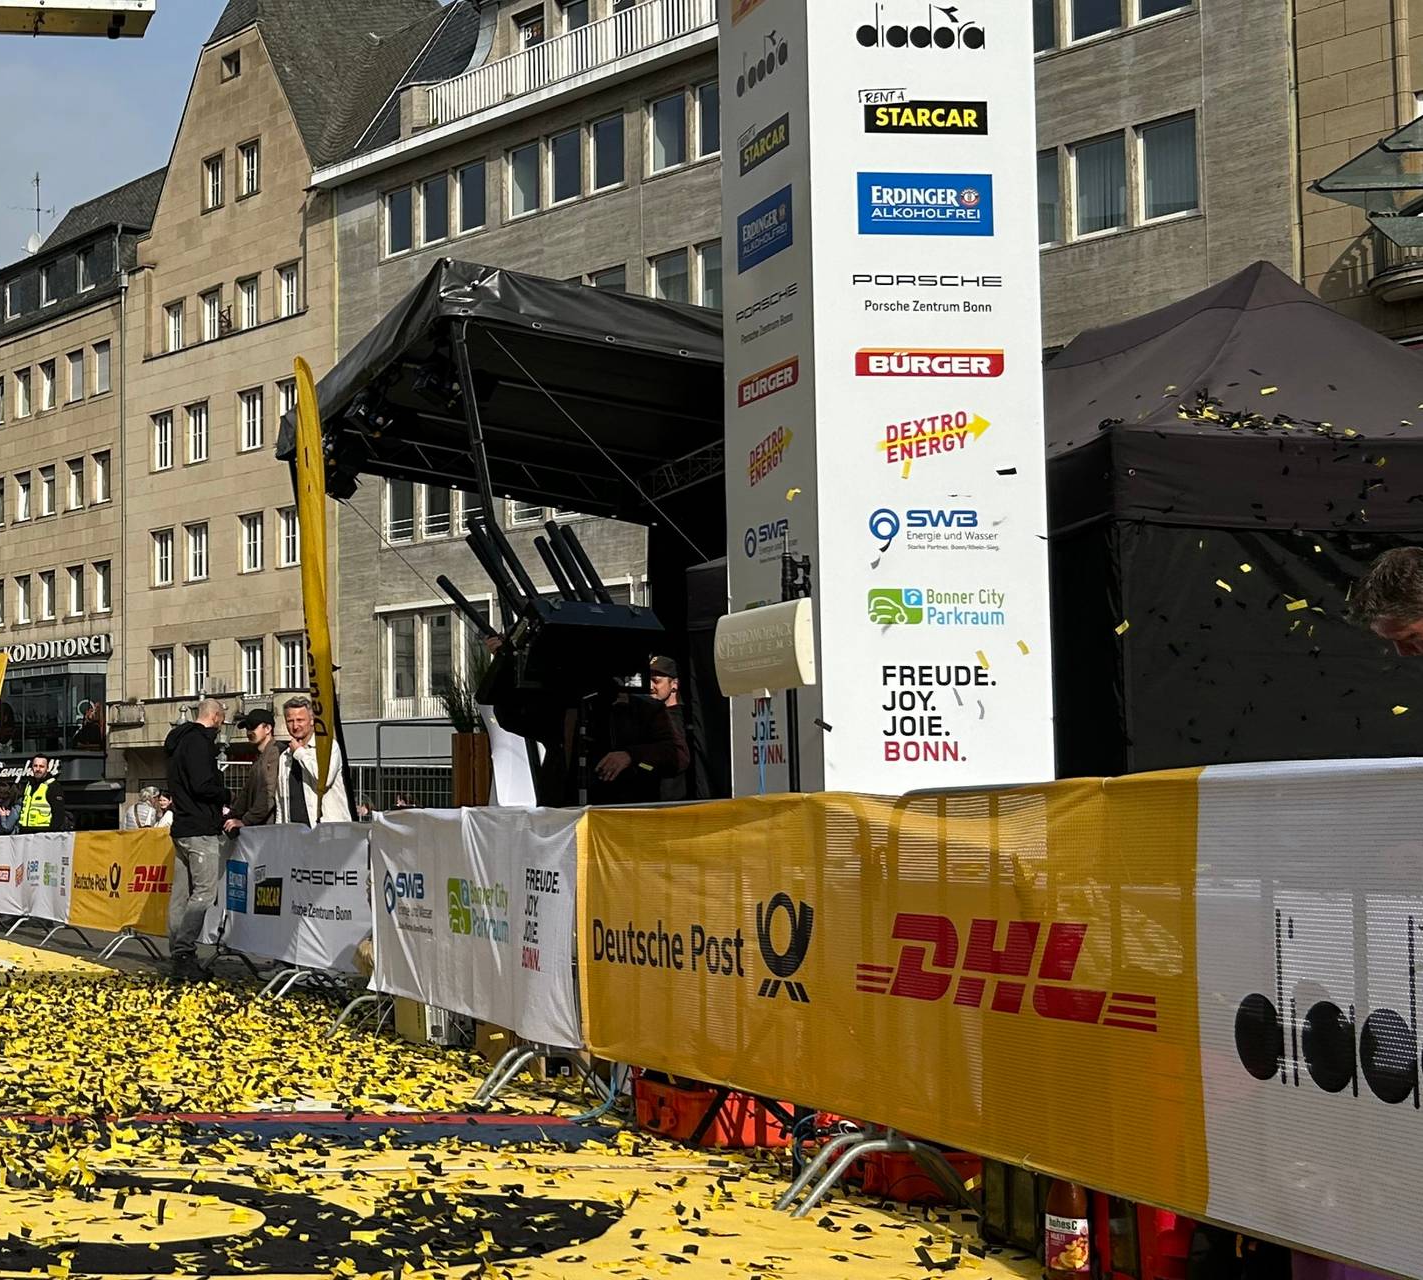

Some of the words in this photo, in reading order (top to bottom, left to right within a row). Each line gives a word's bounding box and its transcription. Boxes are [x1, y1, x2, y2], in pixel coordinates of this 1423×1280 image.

[856, 3, 986, 50] diadora
[864, 92, 894, 104] RENT
[896, 90, 905, 101] A
[875, 107, 978, 128] STARCAR
[743, 124, 786, 167] STARCAR
[870, 185, 959, 207] ERDINGER
[742, 208, 778, 242] ERDINGER
[871, 207, 980, 220] ALKOHOLFREI
[852, 274, 1002, 287] PORSCHE
[735, 282, 798, 324] PORSCHE
[864, 299, 910, 312] Porsche
[913, 300, 960, 312] Zentrum
[963, 301, 992, 312] Bonn
[868, 351, 991, 375] BÜRGER
[742, 366, 794, 402] BÜRGER
[886, 411, 968, 444] DEXTRO
[749, 426, 784, 468] DEXTRO
[886, 430, 968, 464] ENERGY
[749, 443, 785, 488] ENERGY
[906, 509, 978, 528] SWB
[906, 530, 942, 542] Energie
[944, 531, 962, 541] und
[965, 531, 999, 541] Wasser
[926, 588, 975, 605] Bonner
[978, 588, 1005, 609] City
[927, 606, 1005, 625] Parkraum
[4, 634, 106, 663] KONDITOREI
[882, 665, 997, 687] FREUDE.
[882, 690, 936, 711] JOY.
[882, 715, 950, 737] JOIE.
[884, 741, 967, 762] BONN.
[132, 865, 169, 893] DHL
[395, 872, 425, 900] SWB
[525, 867, 560, 894] FREUDE.
[308, 902, 335, 920] Zentrum
[335, 905, 352, 920] Bonn
[592, 918, 684, 971] Deutsche
[690, 923, 745, 977] Post
[877, 912, 1112, 1025] DHL
[1235, 908, 1423, 1110] diad
[1049, 1216, 1071, 1230] hohes
[1071, 1220, 1078, 1231] C
